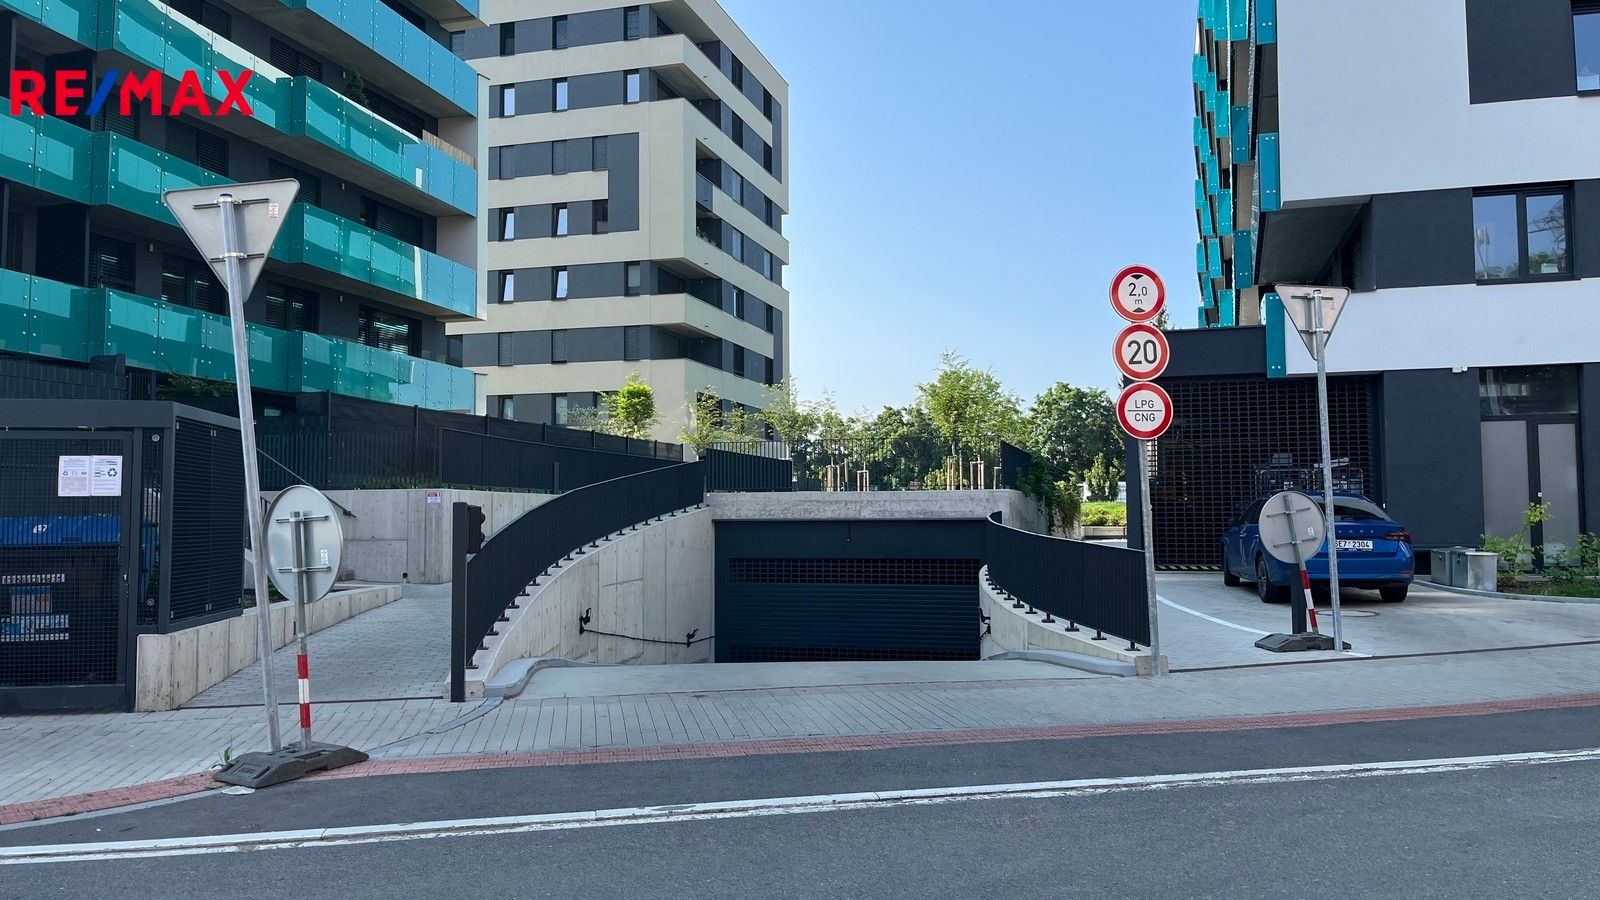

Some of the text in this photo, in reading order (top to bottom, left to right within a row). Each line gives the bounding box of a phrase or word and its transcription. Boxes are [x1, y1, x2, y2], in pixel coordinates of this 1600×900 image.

[1128, 340, 1157, 364] 20
[1134, 400, 1155, 408] LPG
[1134, 413, 1156, 422] CNG
